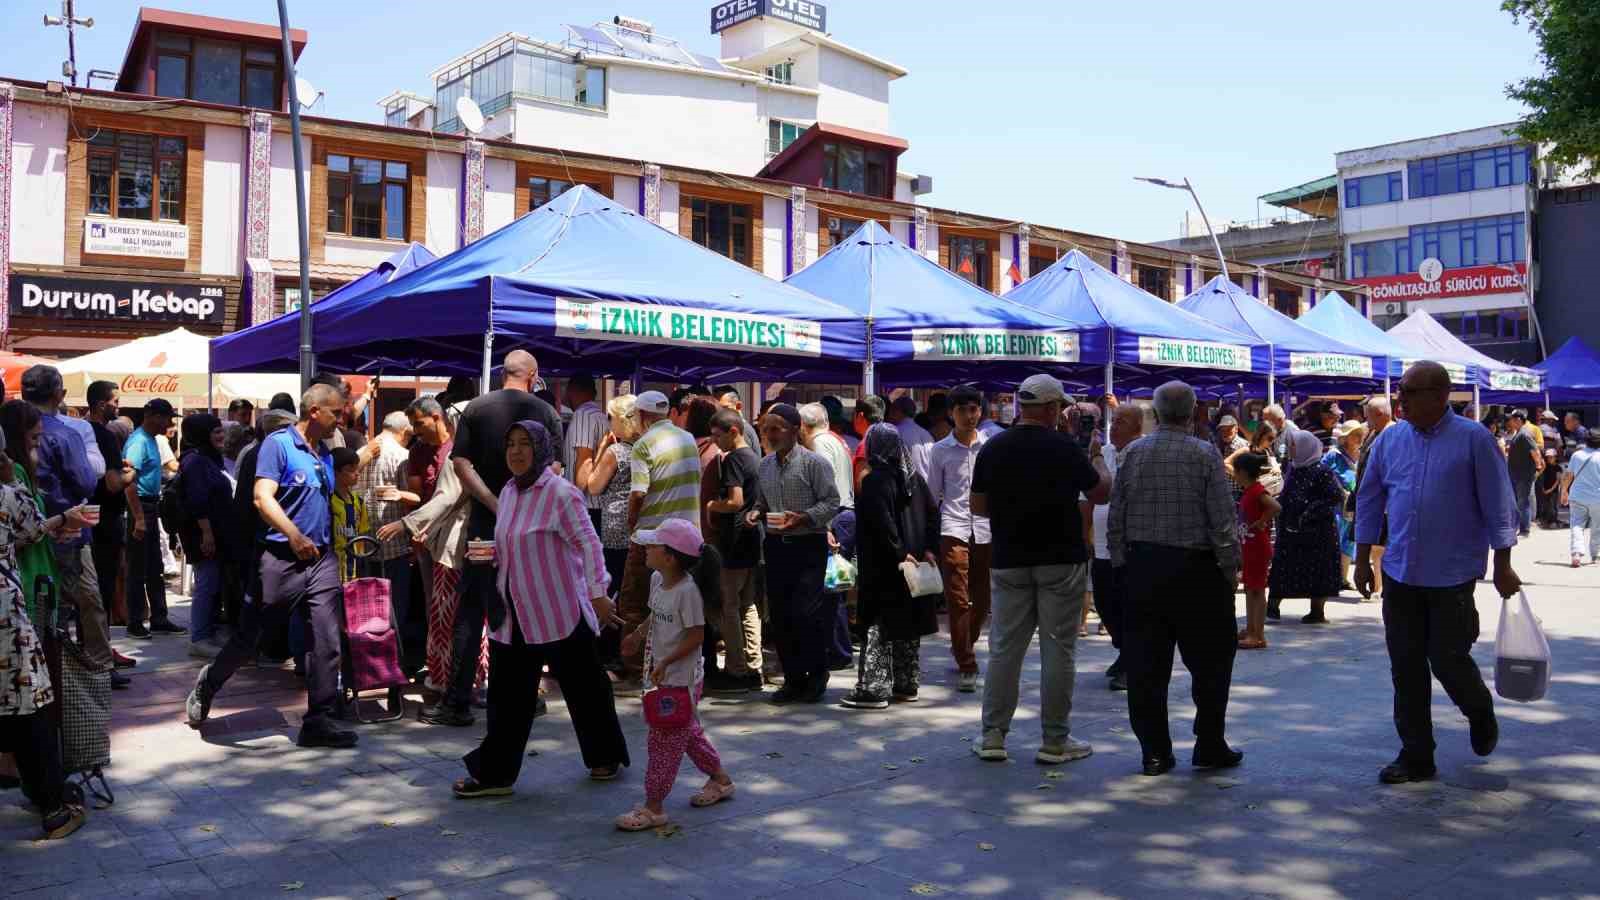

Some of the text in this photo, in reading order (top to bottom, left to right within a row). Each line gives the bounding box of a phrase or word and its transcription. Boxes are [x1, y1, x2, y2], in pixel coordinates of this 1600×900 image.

[716, 0, 757, 19] OTEL
[1446, 275, 1487, 293] SÜRÜCÜ
[600, 306, 786, 349] İZNİK BELEDİYESİ
